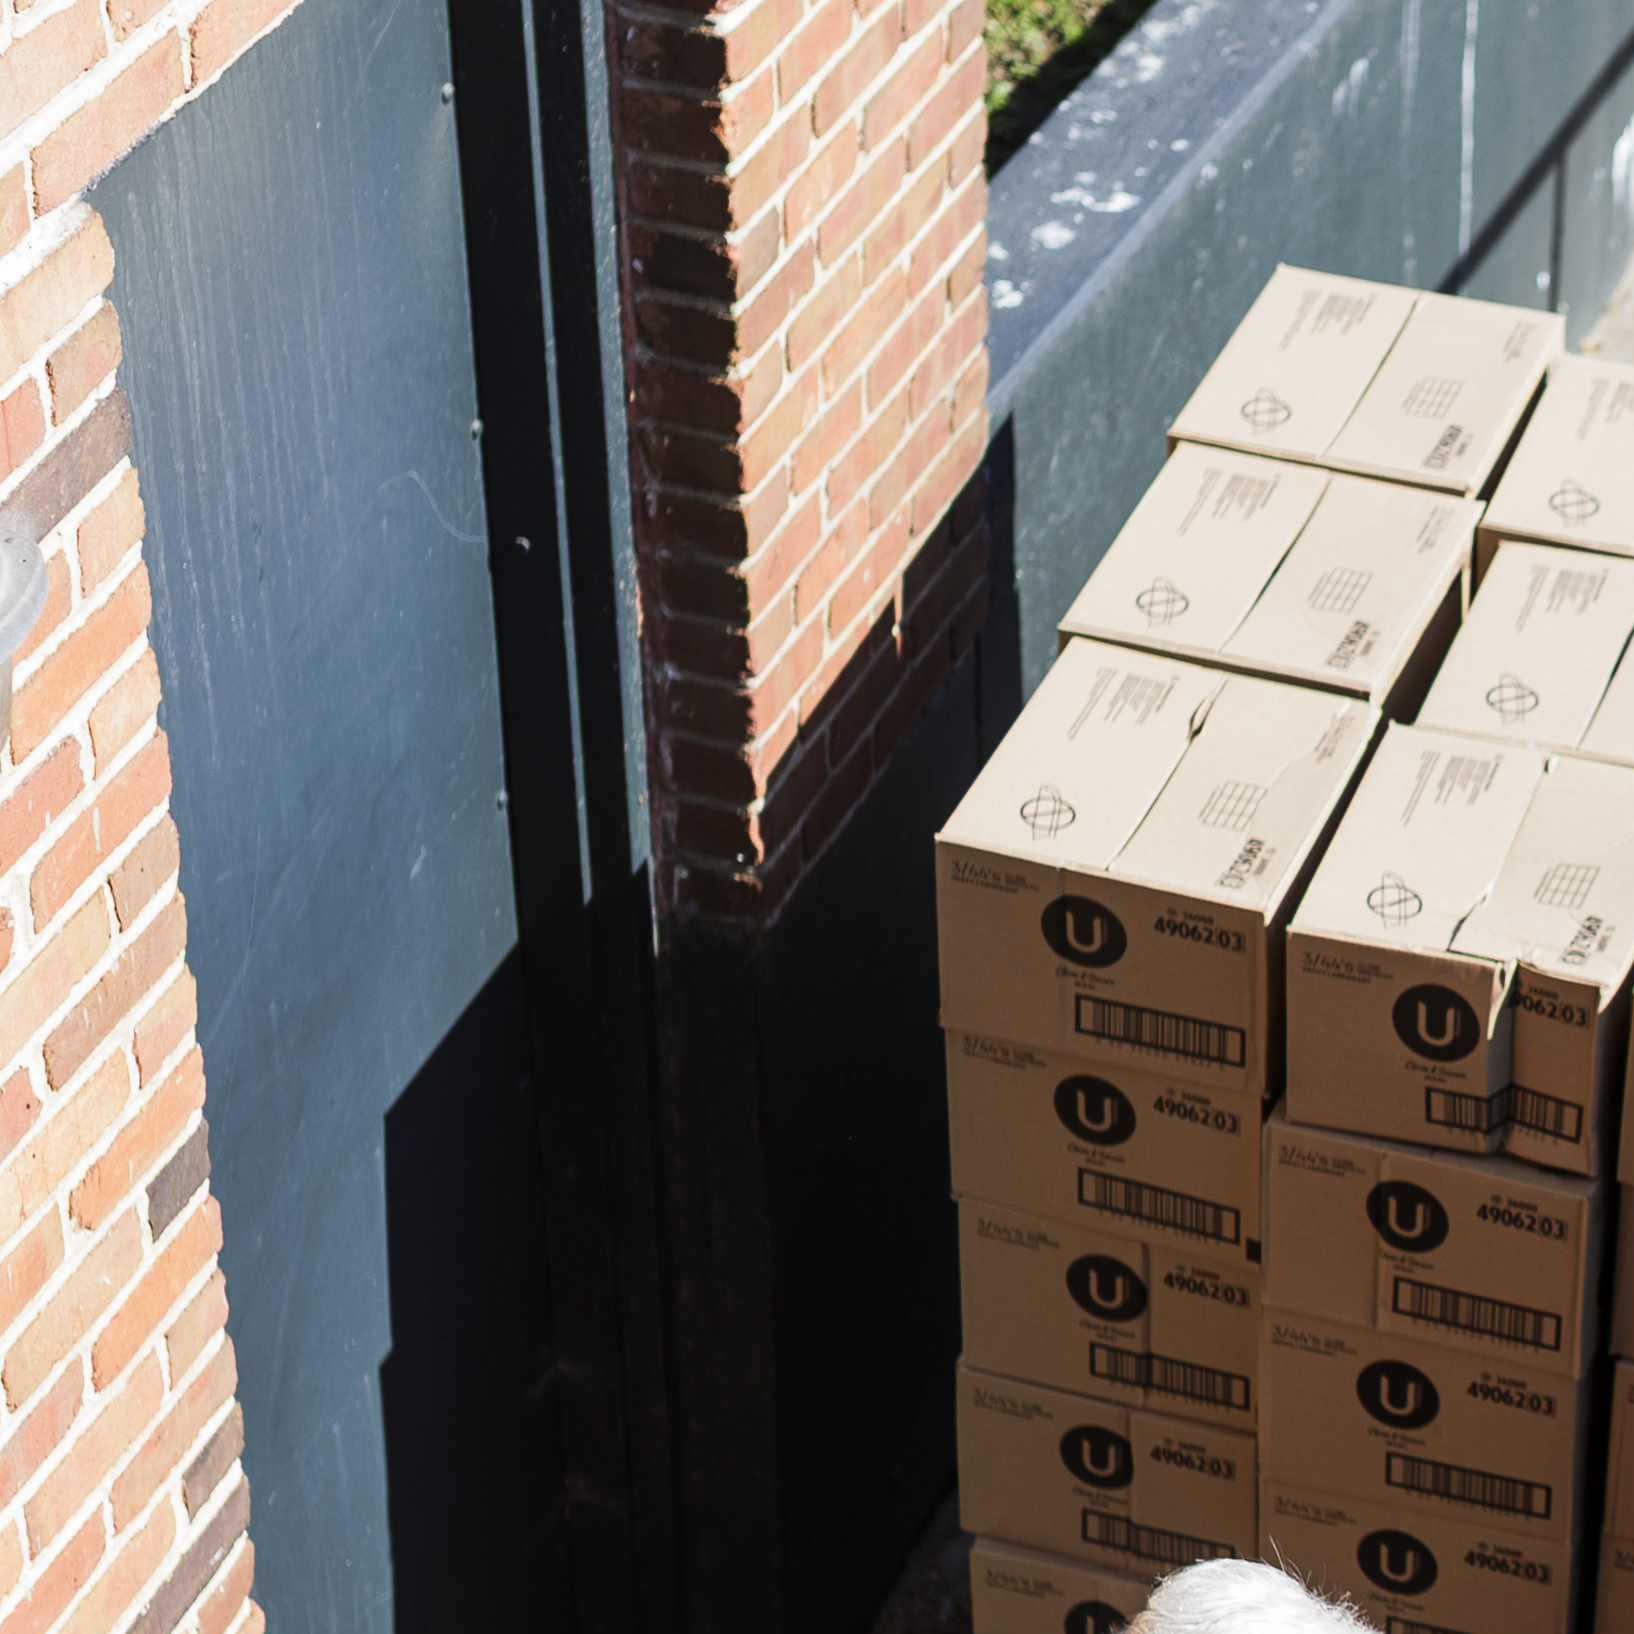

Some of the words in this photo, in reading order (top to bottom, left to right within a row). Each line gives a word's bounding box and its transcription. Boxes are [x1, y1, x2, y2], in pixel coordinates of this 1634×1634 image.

[1066, 909, 1102, 954] U
[1154, 917, 1244, 951] 4906203
[1417, 1001, 1456, 1047] U
[1509, 990, 1588, 1027] 906203
[1077, 1089, 1112, 1132] U
[1154, 1096, 1239, 1133] 4906203
[1388, 1195, 1424, 1238] U
[1477, 1203, 1565, 1240] 4906203
[1089, 1268, 1124, 1310] U
[1163, 1272, 1247, 1306] 4906203
[1380, 1374, 1415, 1417] U
[1467, 1381, 1553, 1416] 4906203
[1082, 1437, 1116, 1477] U
[1380, 1543, 1414, 1583] U
[1464, 1550, 1549, 1584] 4906203
